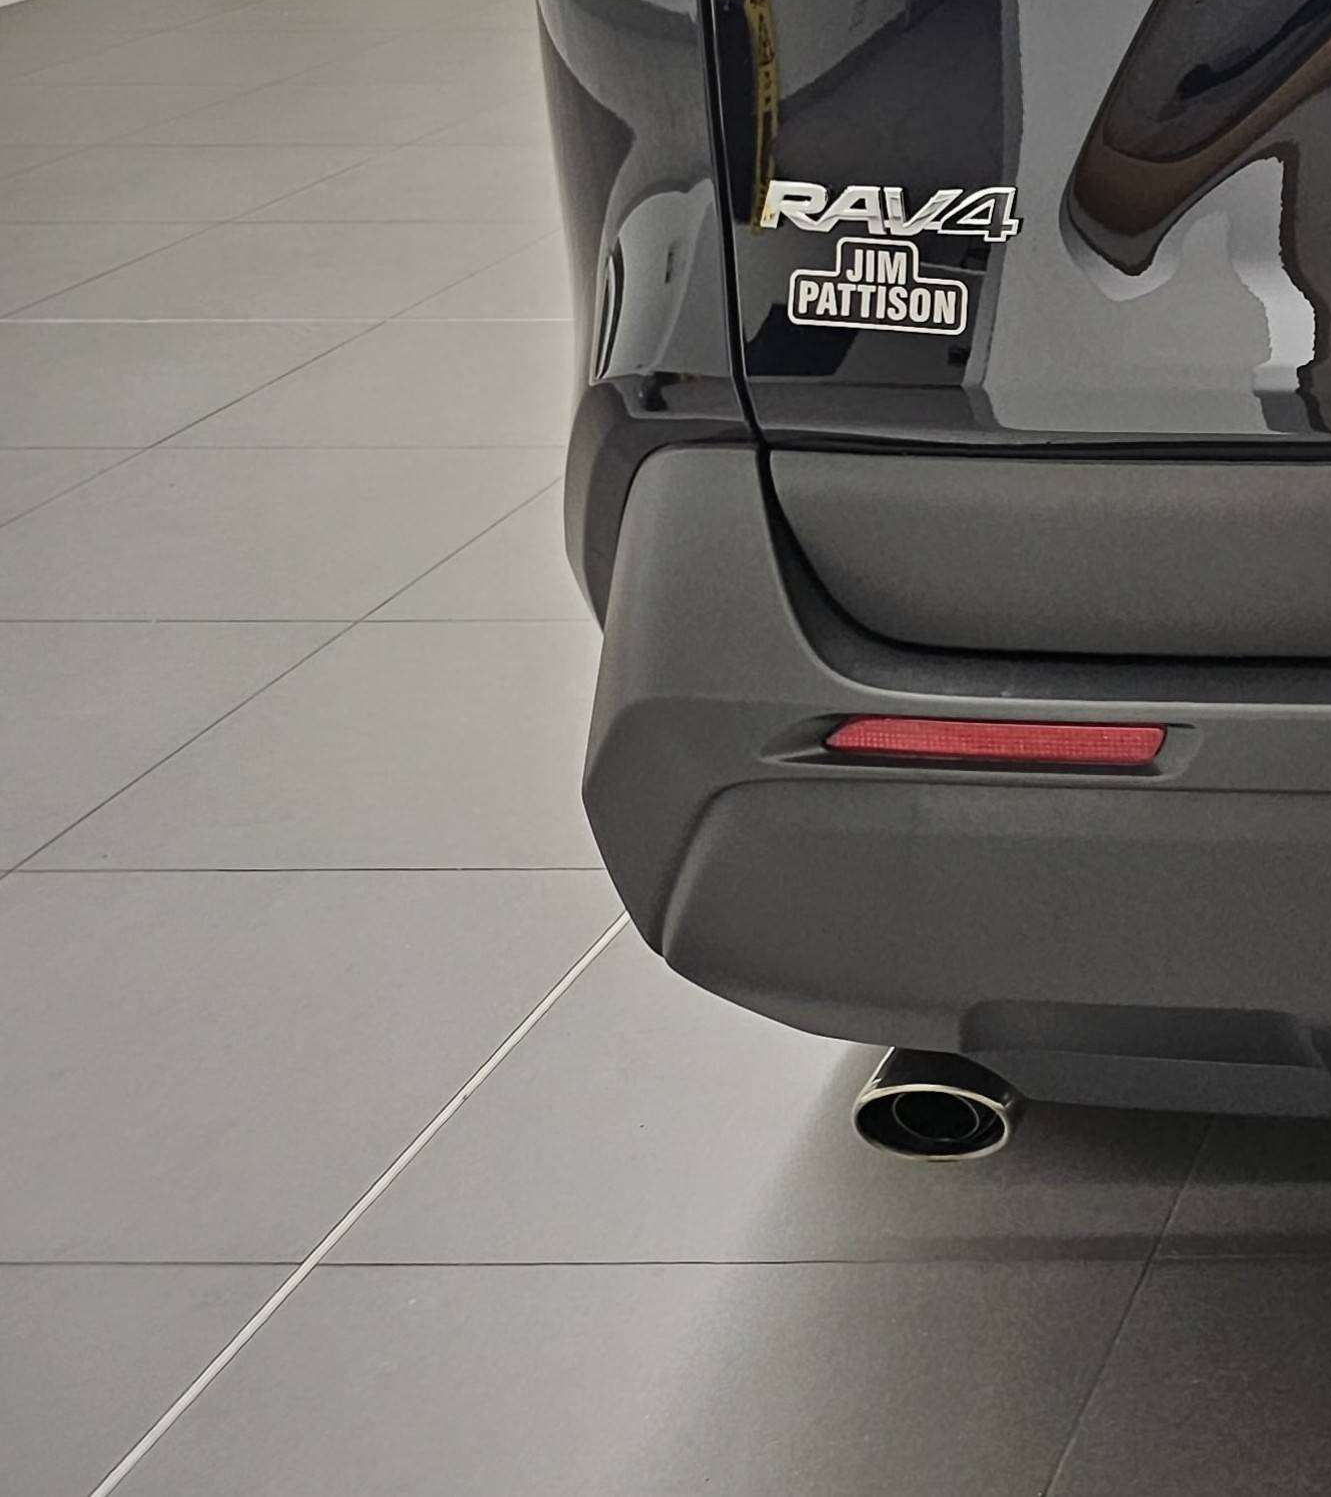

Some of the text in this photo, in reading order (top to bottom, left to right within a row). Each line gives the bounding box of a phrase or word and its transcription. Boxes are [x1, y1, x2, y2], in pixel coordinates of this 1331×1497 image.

[760, 180, 1019, 242] RAV4
[846, 249, 907, 285] JIM
[798, 280, 956, 325] PATTISON
